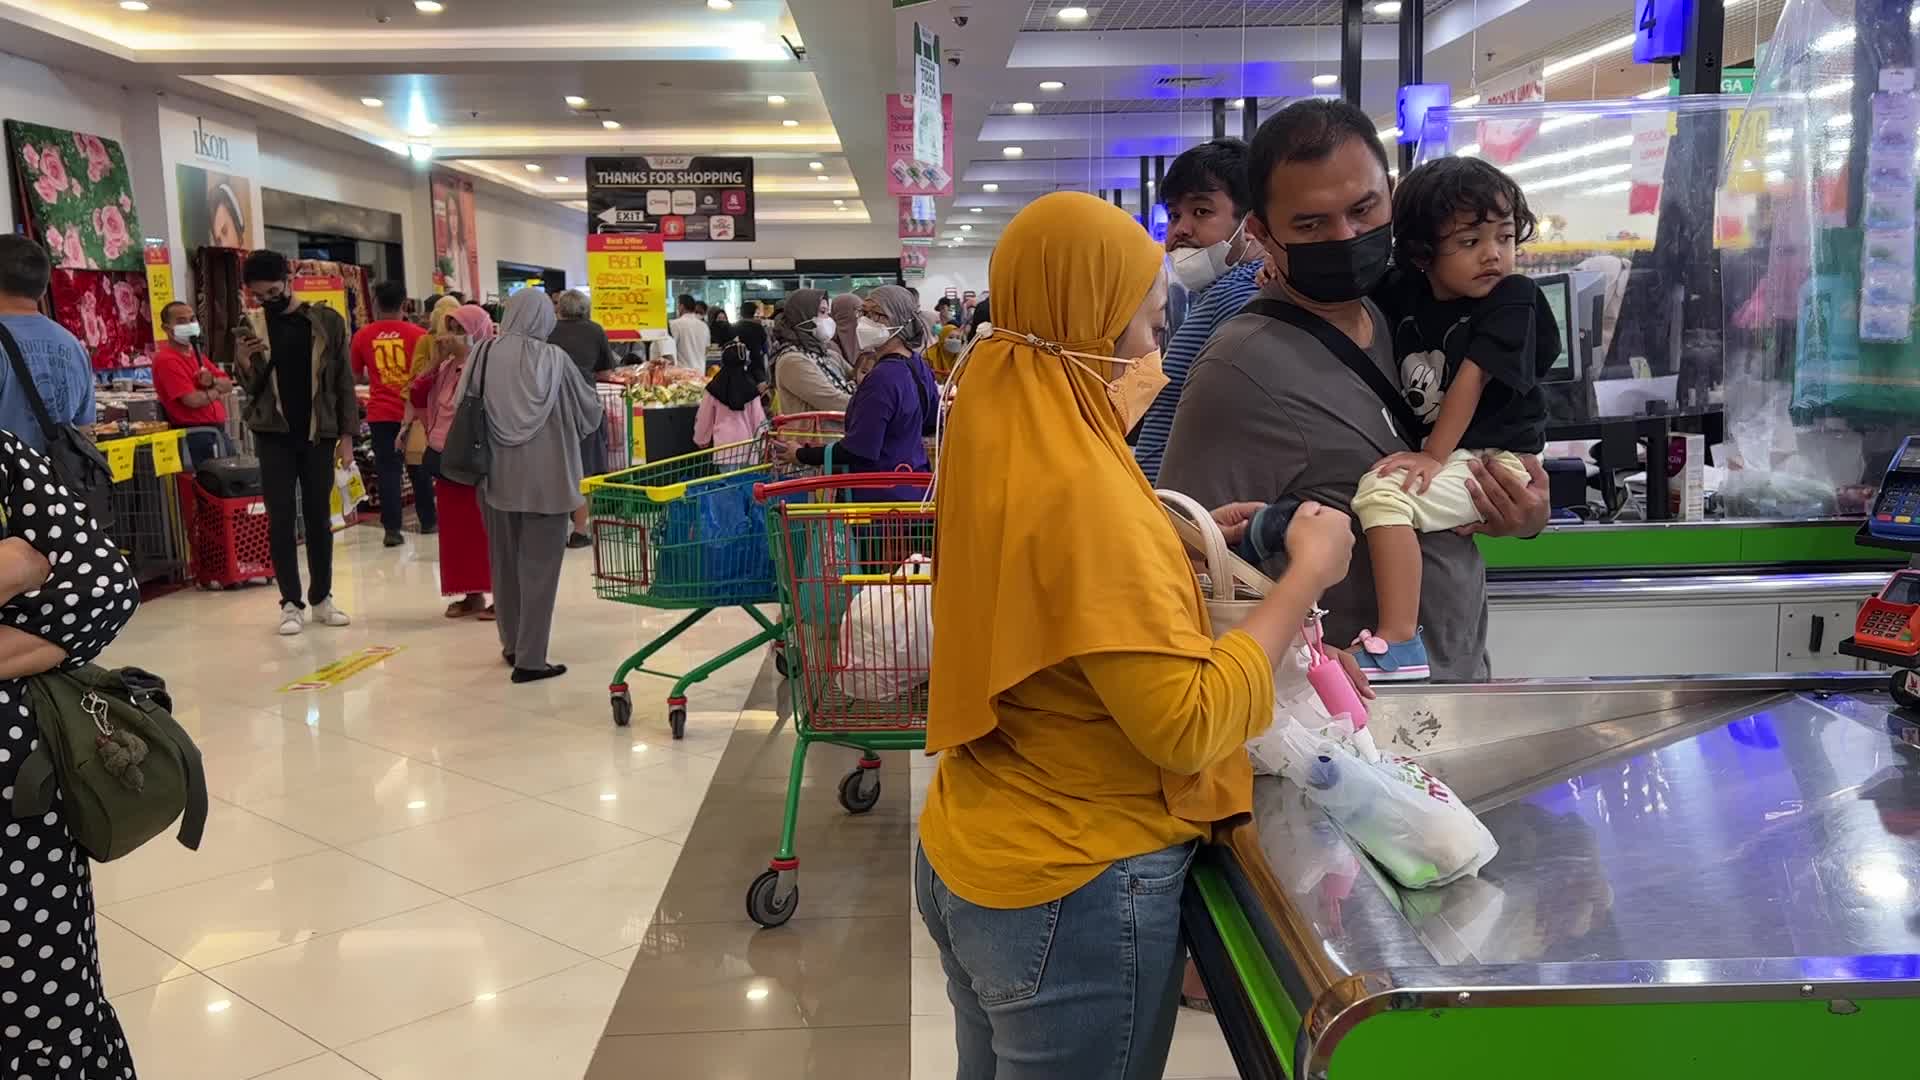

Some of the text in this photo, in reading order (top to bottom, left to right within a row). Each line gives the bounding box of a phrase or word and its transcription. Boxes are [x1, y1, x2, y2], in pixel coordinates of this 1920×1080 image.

[1639, 0, 1656, 39] 4
[597, 172, 742, 184] THANKS FOR SHOPPING
[616, 211, 642, 221] EXIT
